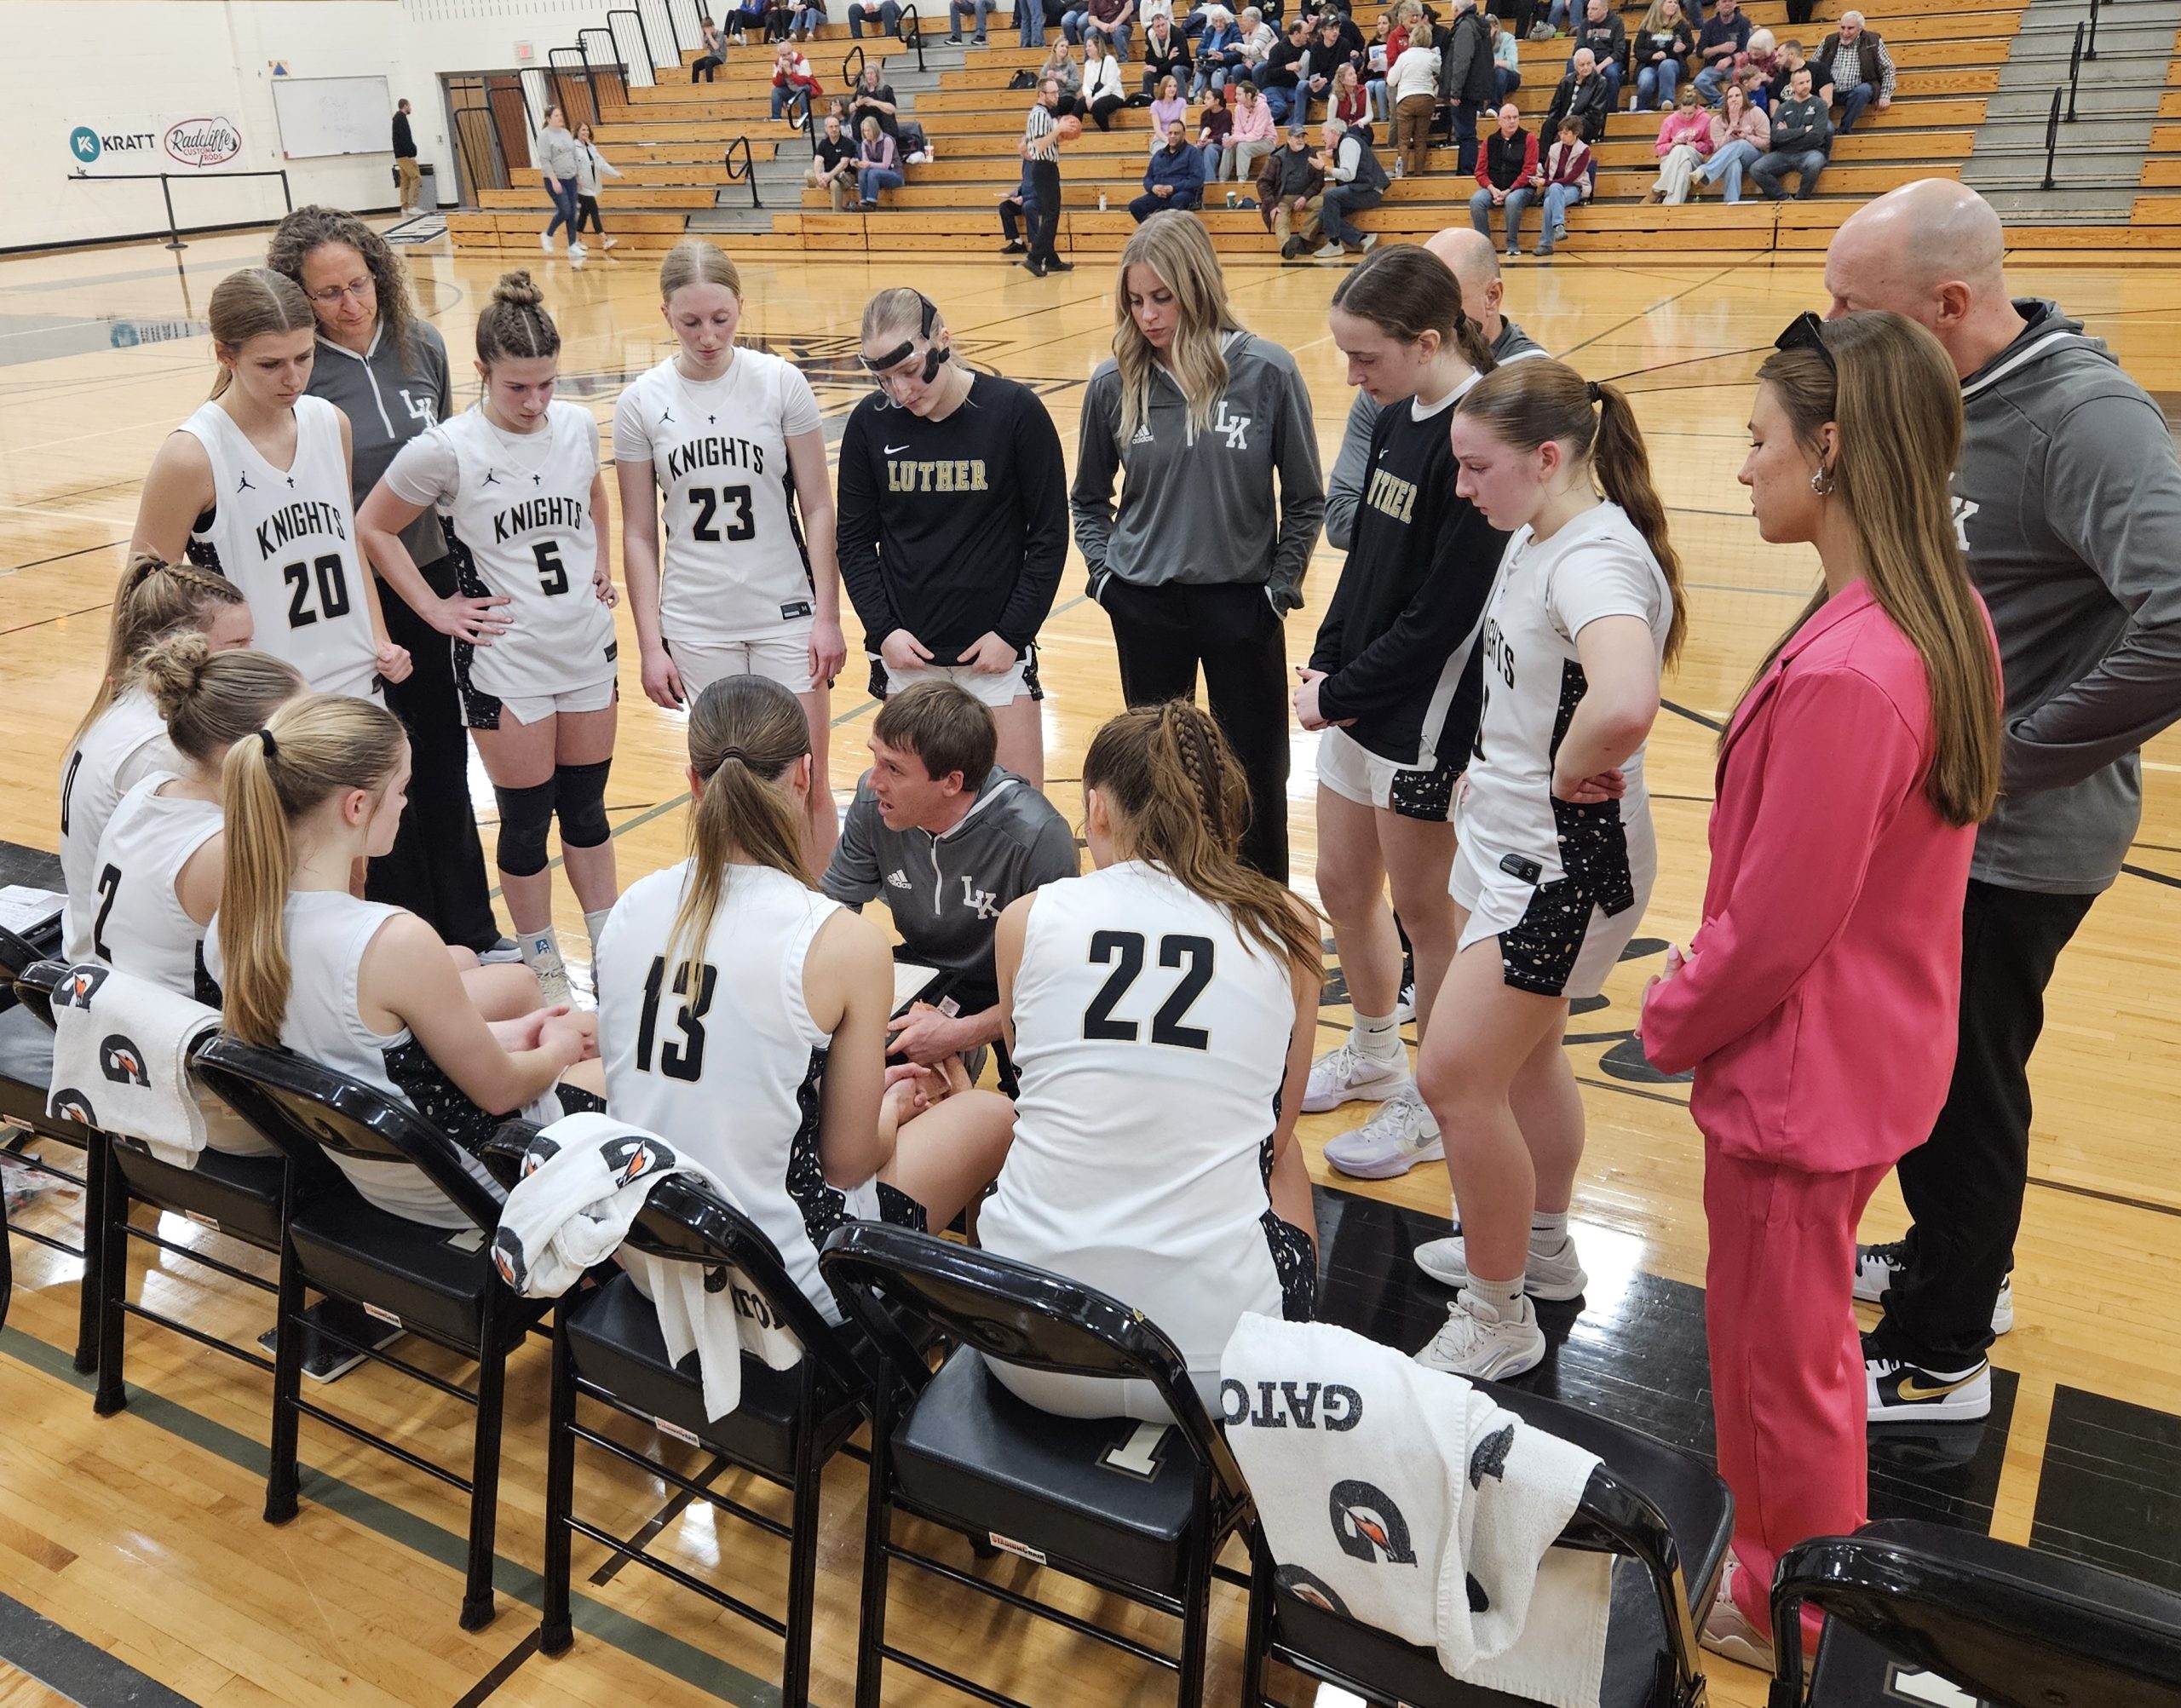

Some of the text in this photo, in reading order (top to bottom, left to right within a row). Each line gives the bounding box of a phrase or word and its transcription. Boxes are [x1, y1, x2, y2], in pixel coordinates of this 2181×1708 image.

[101, 134, 155, 152] KRATT
[171, 128, 231, 152] Radcliffe
[183, 147, 211, 157] CUSTOM
[399, 389, 438, 428] LK
[1215, 401, 1251, 450] LK
[668, 437, 763, 481] KNIGHTS
[1131, 434, 1154, 445] adidas
[887, 459, 988, 492] LUTHER
[256, 501, 346, 561] KNIGHTS
[493, 497, 583, 545] KNIGHTS
[688, 484, 756, 543] 23
[283, 551, 351, 631] 20
[530, 538, 570, 598] 5
[1526, 867, 1534, 877] S
[94, 862, 123, 965] 2
[961, 876, 1001, 919] LK
[1080, 927, 1218, 1055] 22
[635, 952, 720, 1084] 13
[1219, 1377, 1363, 1433] GATO
